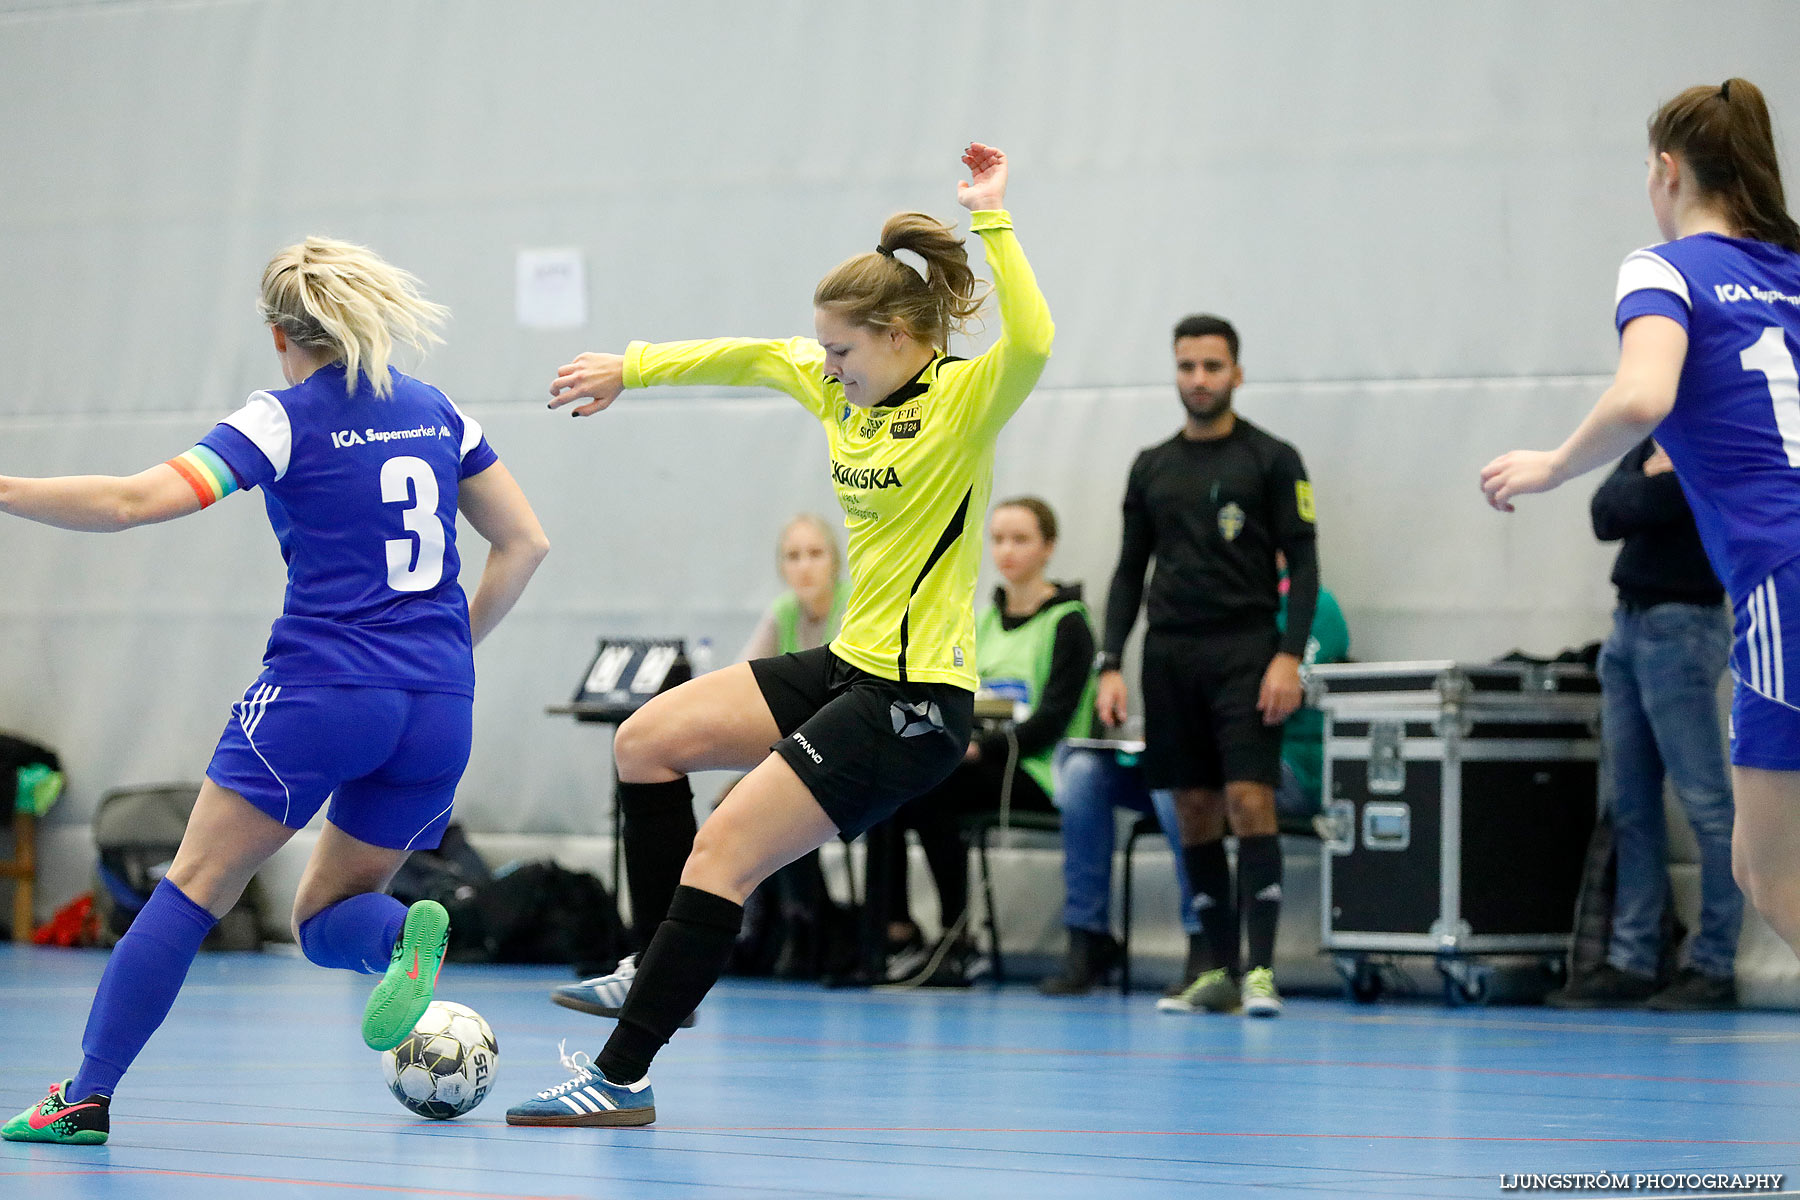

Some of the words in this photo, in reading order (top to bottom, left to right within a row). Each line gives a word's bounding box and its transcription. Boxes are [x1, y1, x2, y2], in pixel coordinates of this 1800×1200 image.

[1714, 283, 1752, 302] ICA
[1739, 327, 1800, 468] 1
[897, 407, 919, 420] FIF
[330, 429, 366, 448] ICA
[365, 424, 436, 443] Supermarket
[893, 424, 903, 433] 19
[908, 422, 917, 432] 24
[380, 456, 445, 591] 3
[792, 732, 824, 764] STANNO
